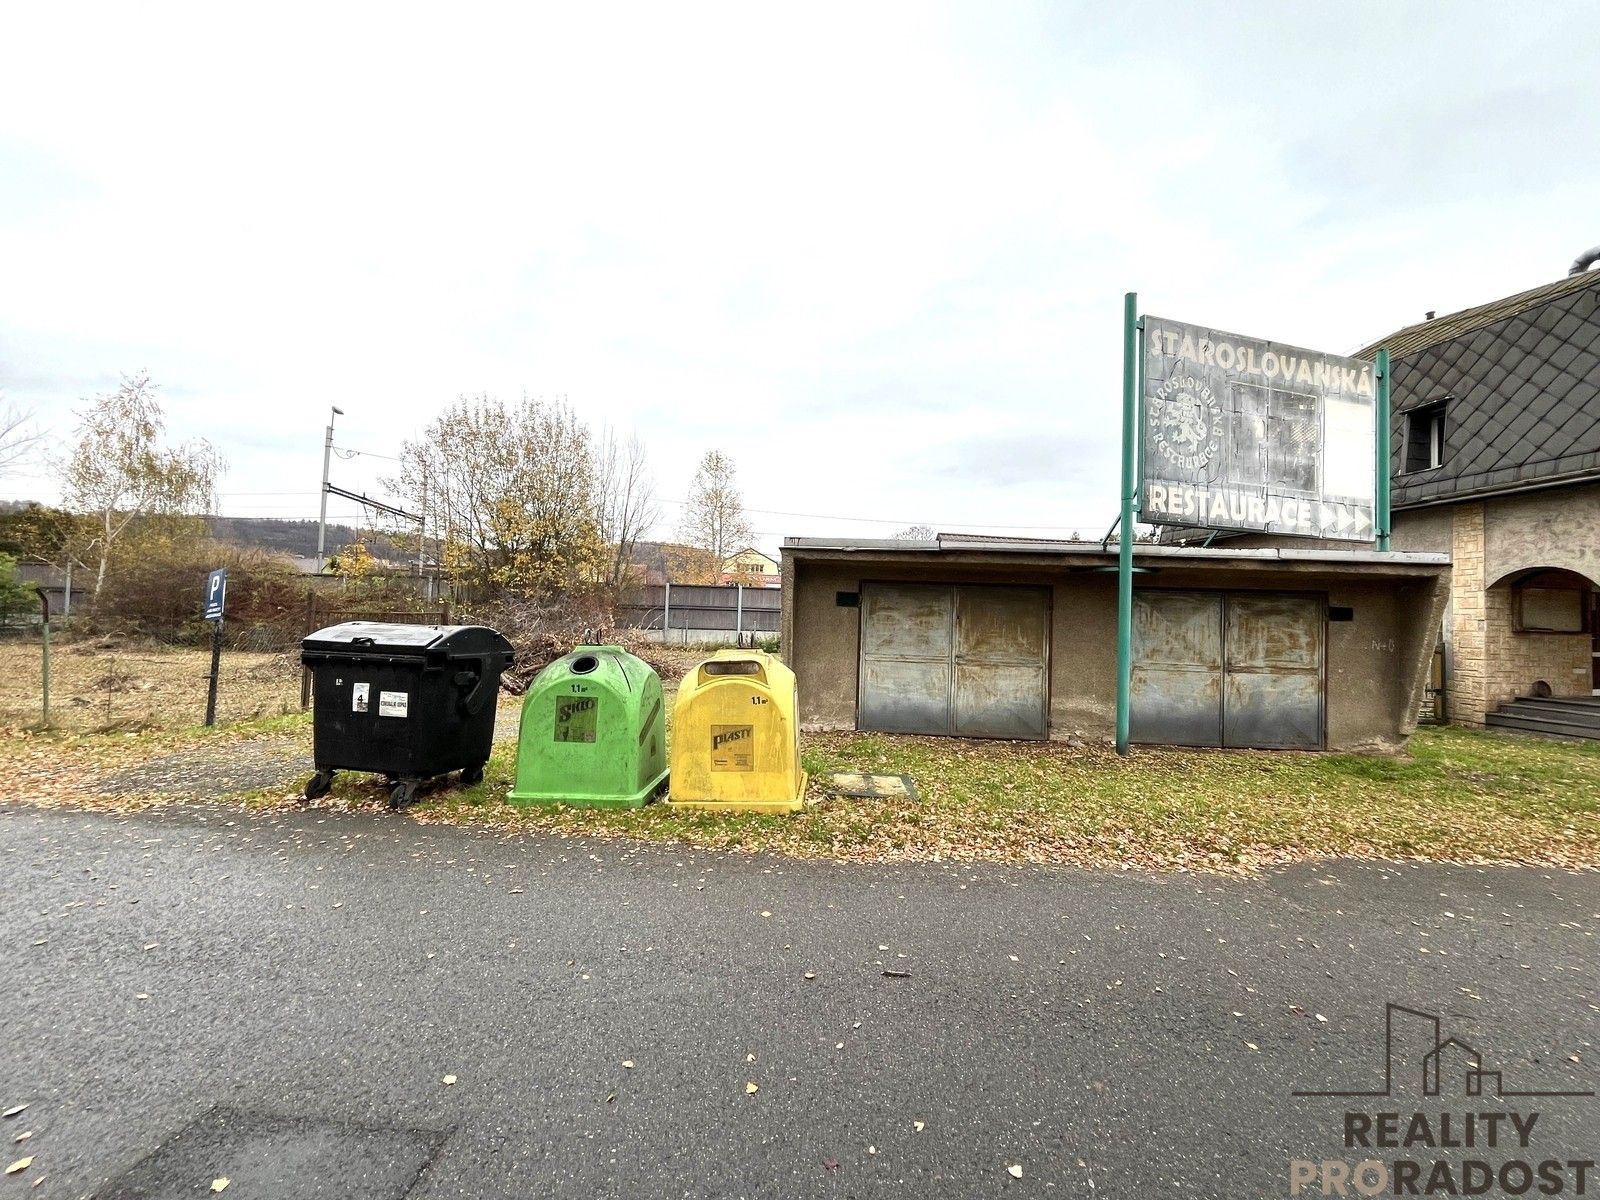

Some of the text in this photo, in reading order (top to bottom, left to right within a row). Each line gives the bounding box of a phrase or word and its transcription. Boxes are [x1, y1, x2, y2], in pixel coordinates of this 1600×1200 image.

[1151, 328, 1372, 396] STAROSLOVANSKÁ
[1149, 485, 1311, 528] RESTAURACE
[210, 575, 220, 601] P
[357, 694, 364, 704] 4
[713, 728, 752, 750] PLASTY
